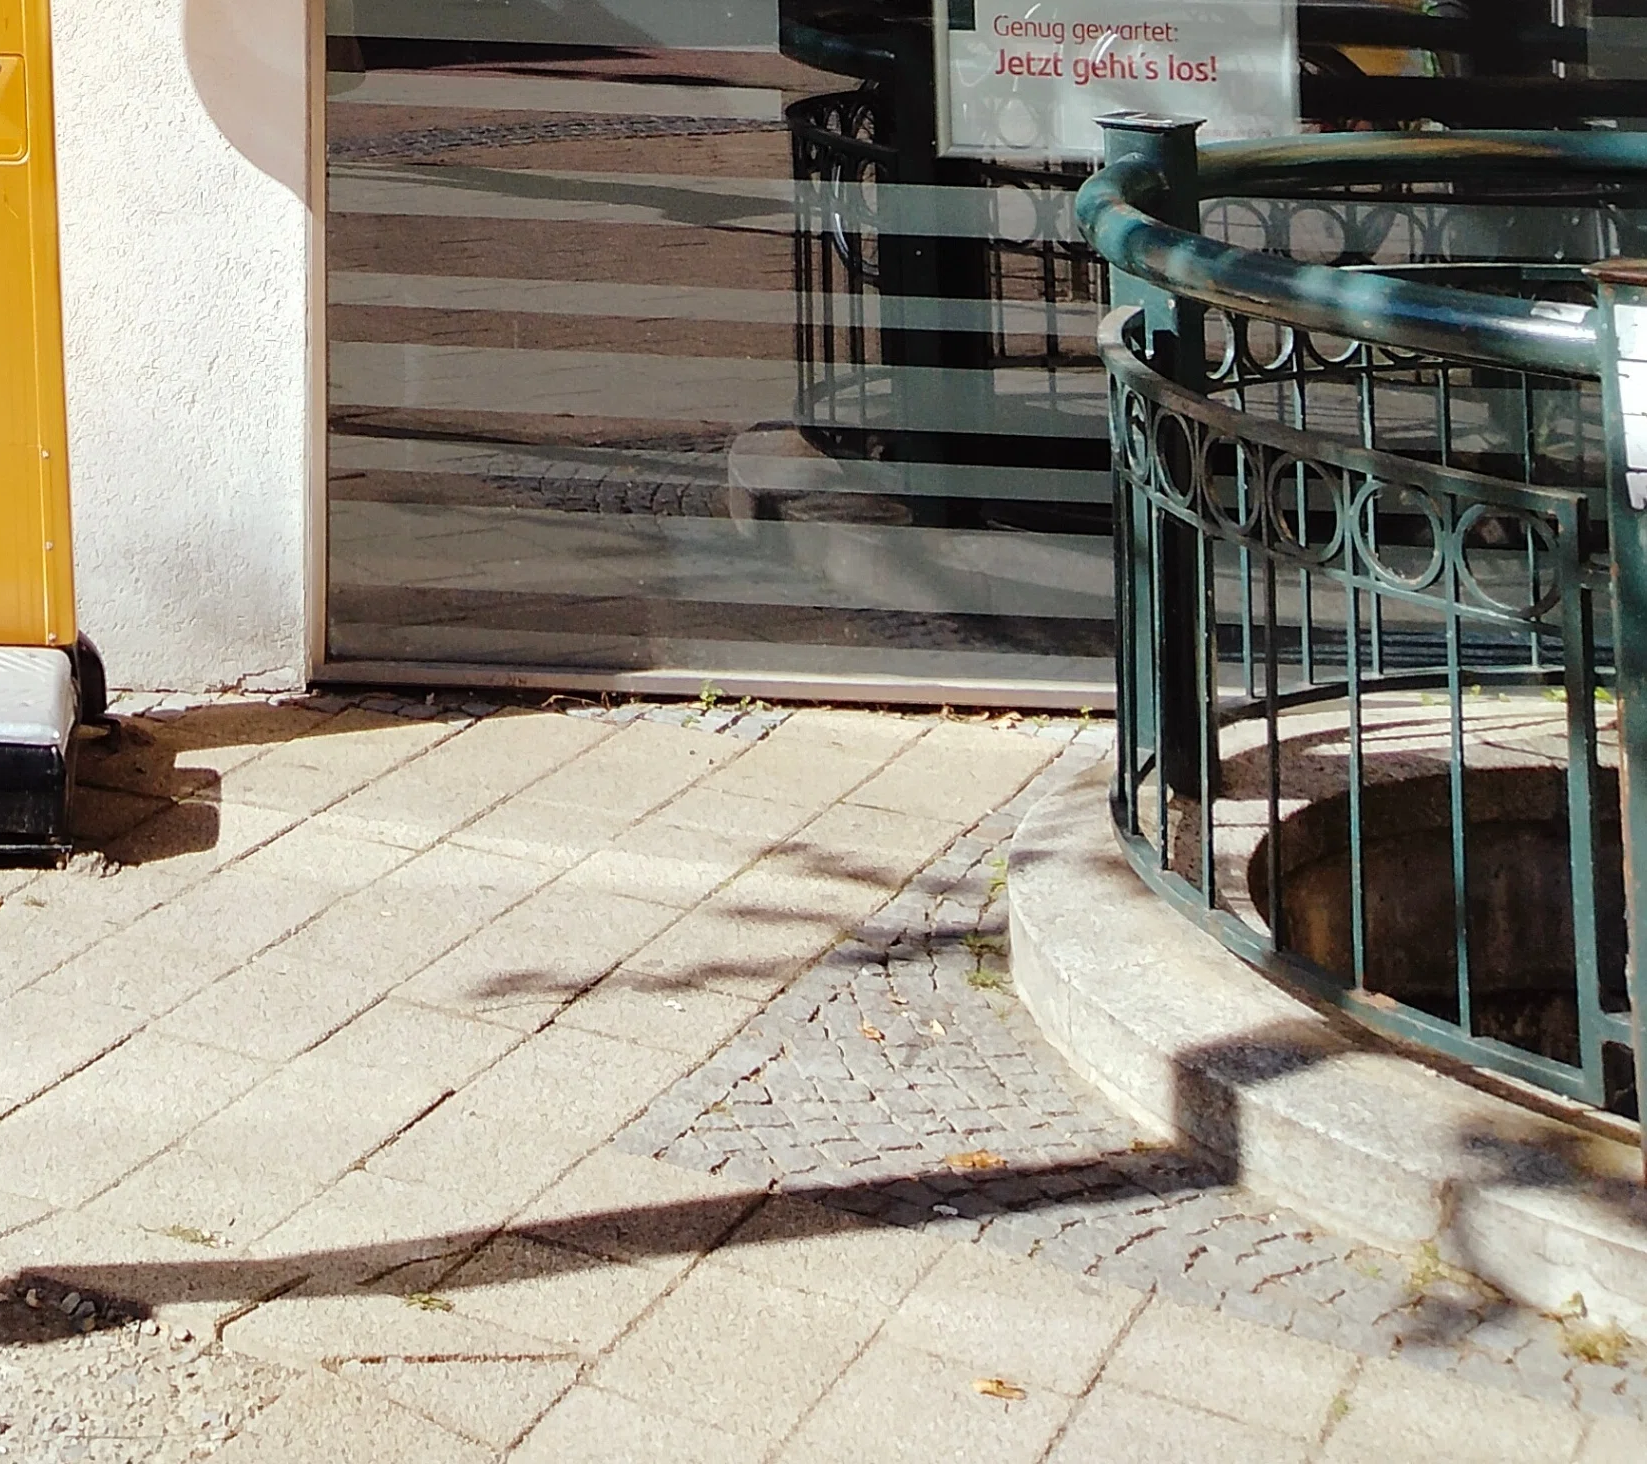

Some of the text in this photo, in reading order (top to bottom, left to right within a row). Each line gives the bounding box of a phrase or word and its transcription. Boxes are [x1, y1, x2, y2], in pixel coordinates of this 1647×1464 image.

[993, 15, 1180, 46] Genug gewartet:
[995, 48, 1064, 78] Jetzt
[1168, 54, 1218, 82] los!
